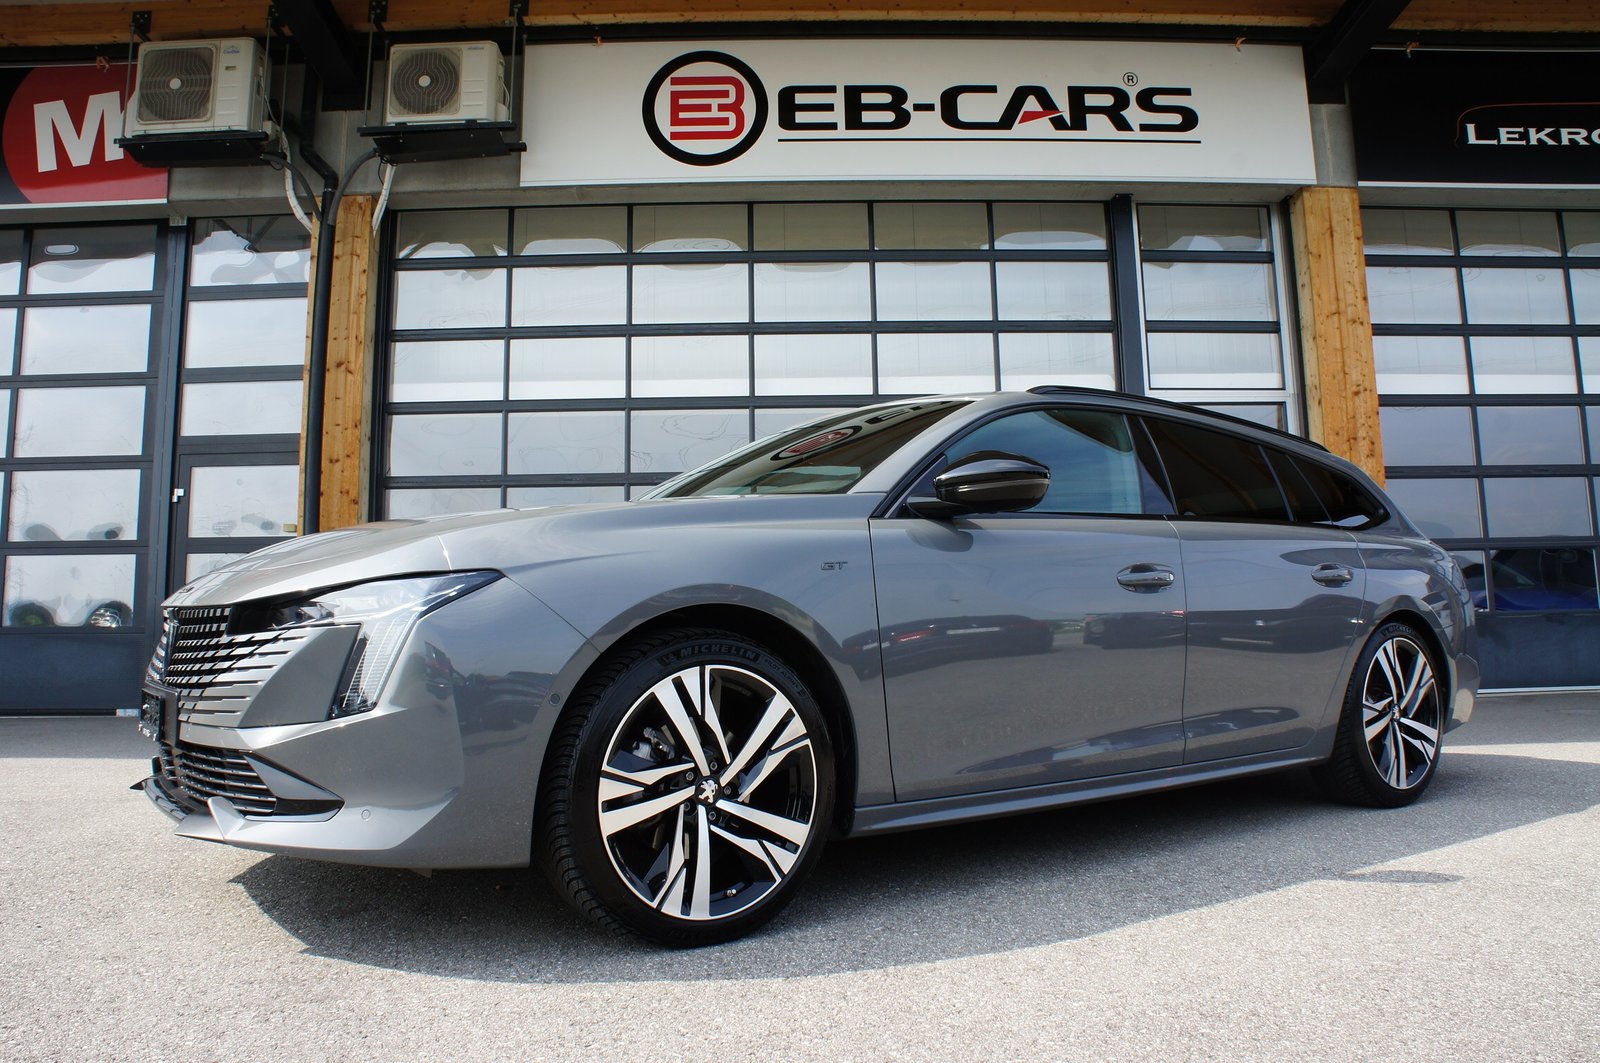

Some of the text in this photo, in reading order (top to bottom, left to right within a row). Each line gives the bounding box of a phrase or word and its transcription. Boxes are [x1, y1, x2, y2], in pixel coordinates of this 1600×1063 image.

[777, 84, 1199, 133] EB-CARS
[33, 90, 125, 173] M
[821, 561, 849, 571] GT
[680, 644, 758, 660] MICHELIN
